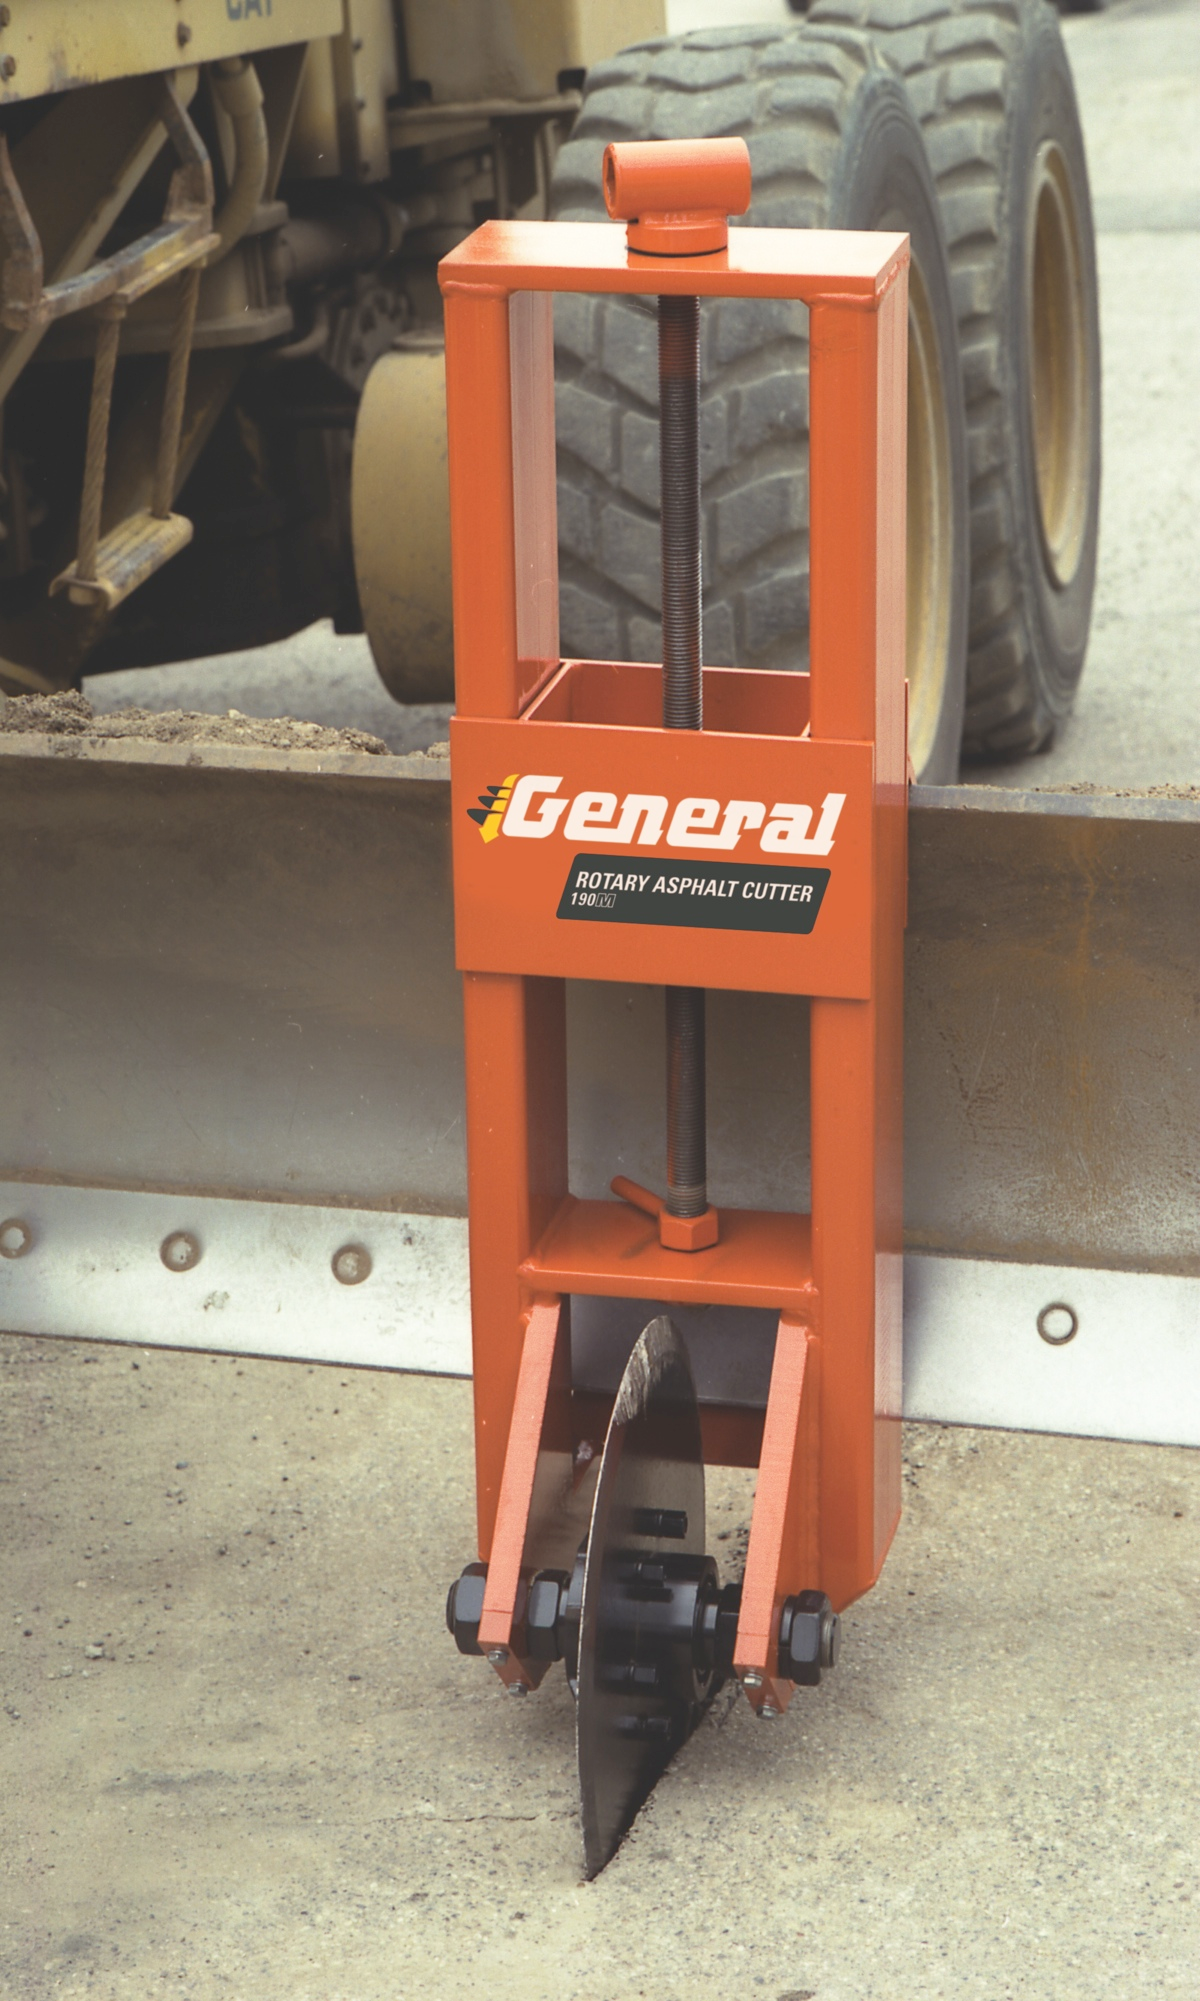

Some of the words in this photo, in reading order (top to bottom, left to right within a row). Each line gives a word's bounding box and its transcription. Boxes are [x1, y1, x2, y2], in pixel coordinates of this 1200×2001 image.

[501, 774, 847, 856] General
[575, 870, 650, 892] ROTARY
[652, 876, 739, 899] ASPHALT
[742, 881, 814, 903] CUTTER
